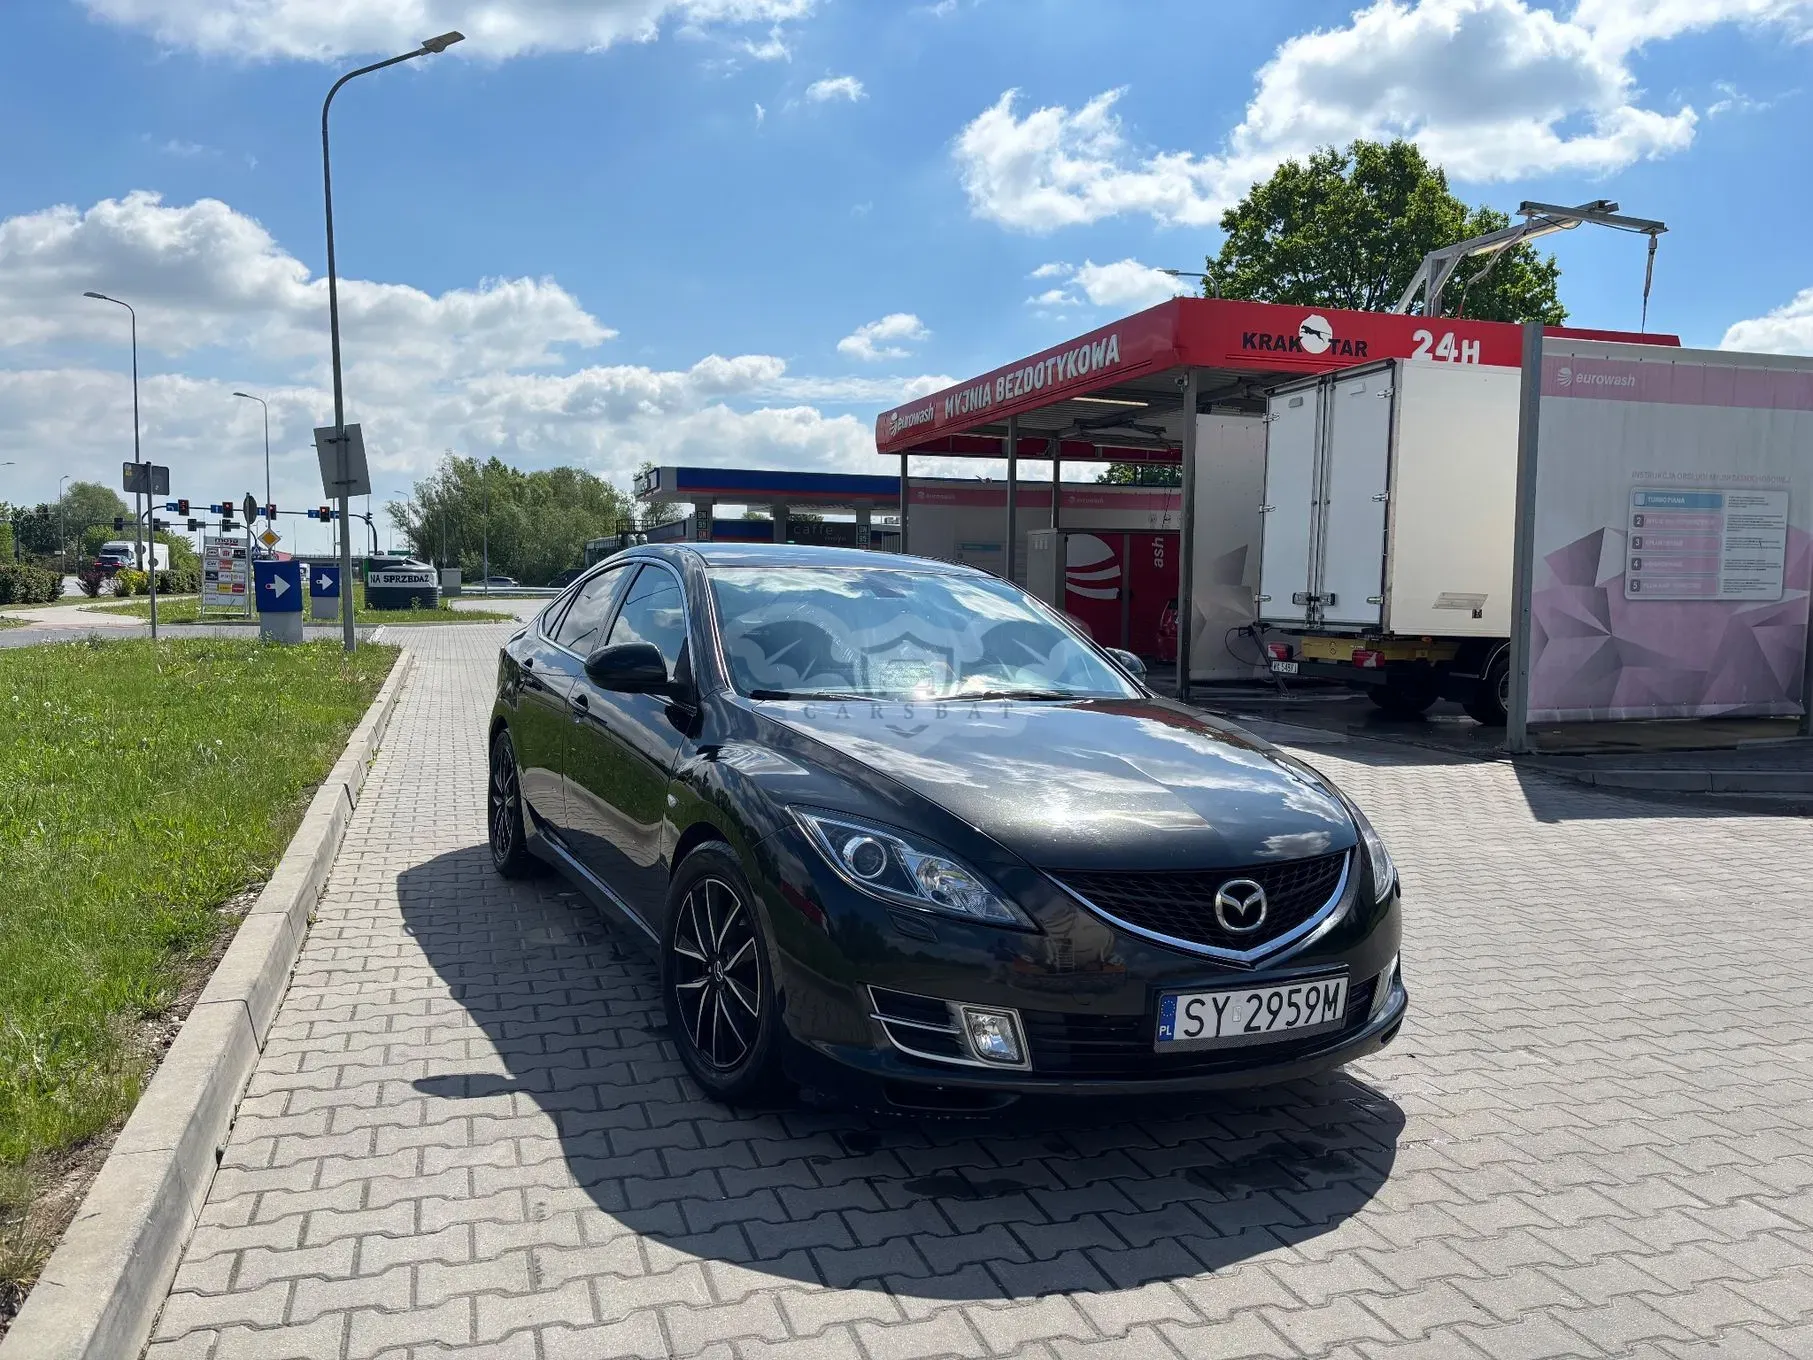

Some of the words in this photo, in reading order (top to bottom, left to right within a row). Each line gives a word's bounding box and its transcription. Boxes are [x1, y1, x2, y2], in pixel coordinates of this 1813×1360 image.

[1242, 331, 1304, 353] KRAK
[1328, 338, 1368, 358] TAR
[1412, 329, 1480, 364] 24H
[897, 402, 935, 431] eurowash
[945, 384, 992, 419] MYJNIA
[996, 333, 1120, 403] BEZDOTYKOWA
[1575, 372, 1636, 387] eurowash
[793, 524, 833, 535] caffe
[1152, 537, 1164, 568] ash
[370, 574, 381, 583] NA
[1183, 995, 1231, 1038] SY
[1243, 982, 1341, 1032] 2959M
[1159, 1025, 1172, 1036] PL
